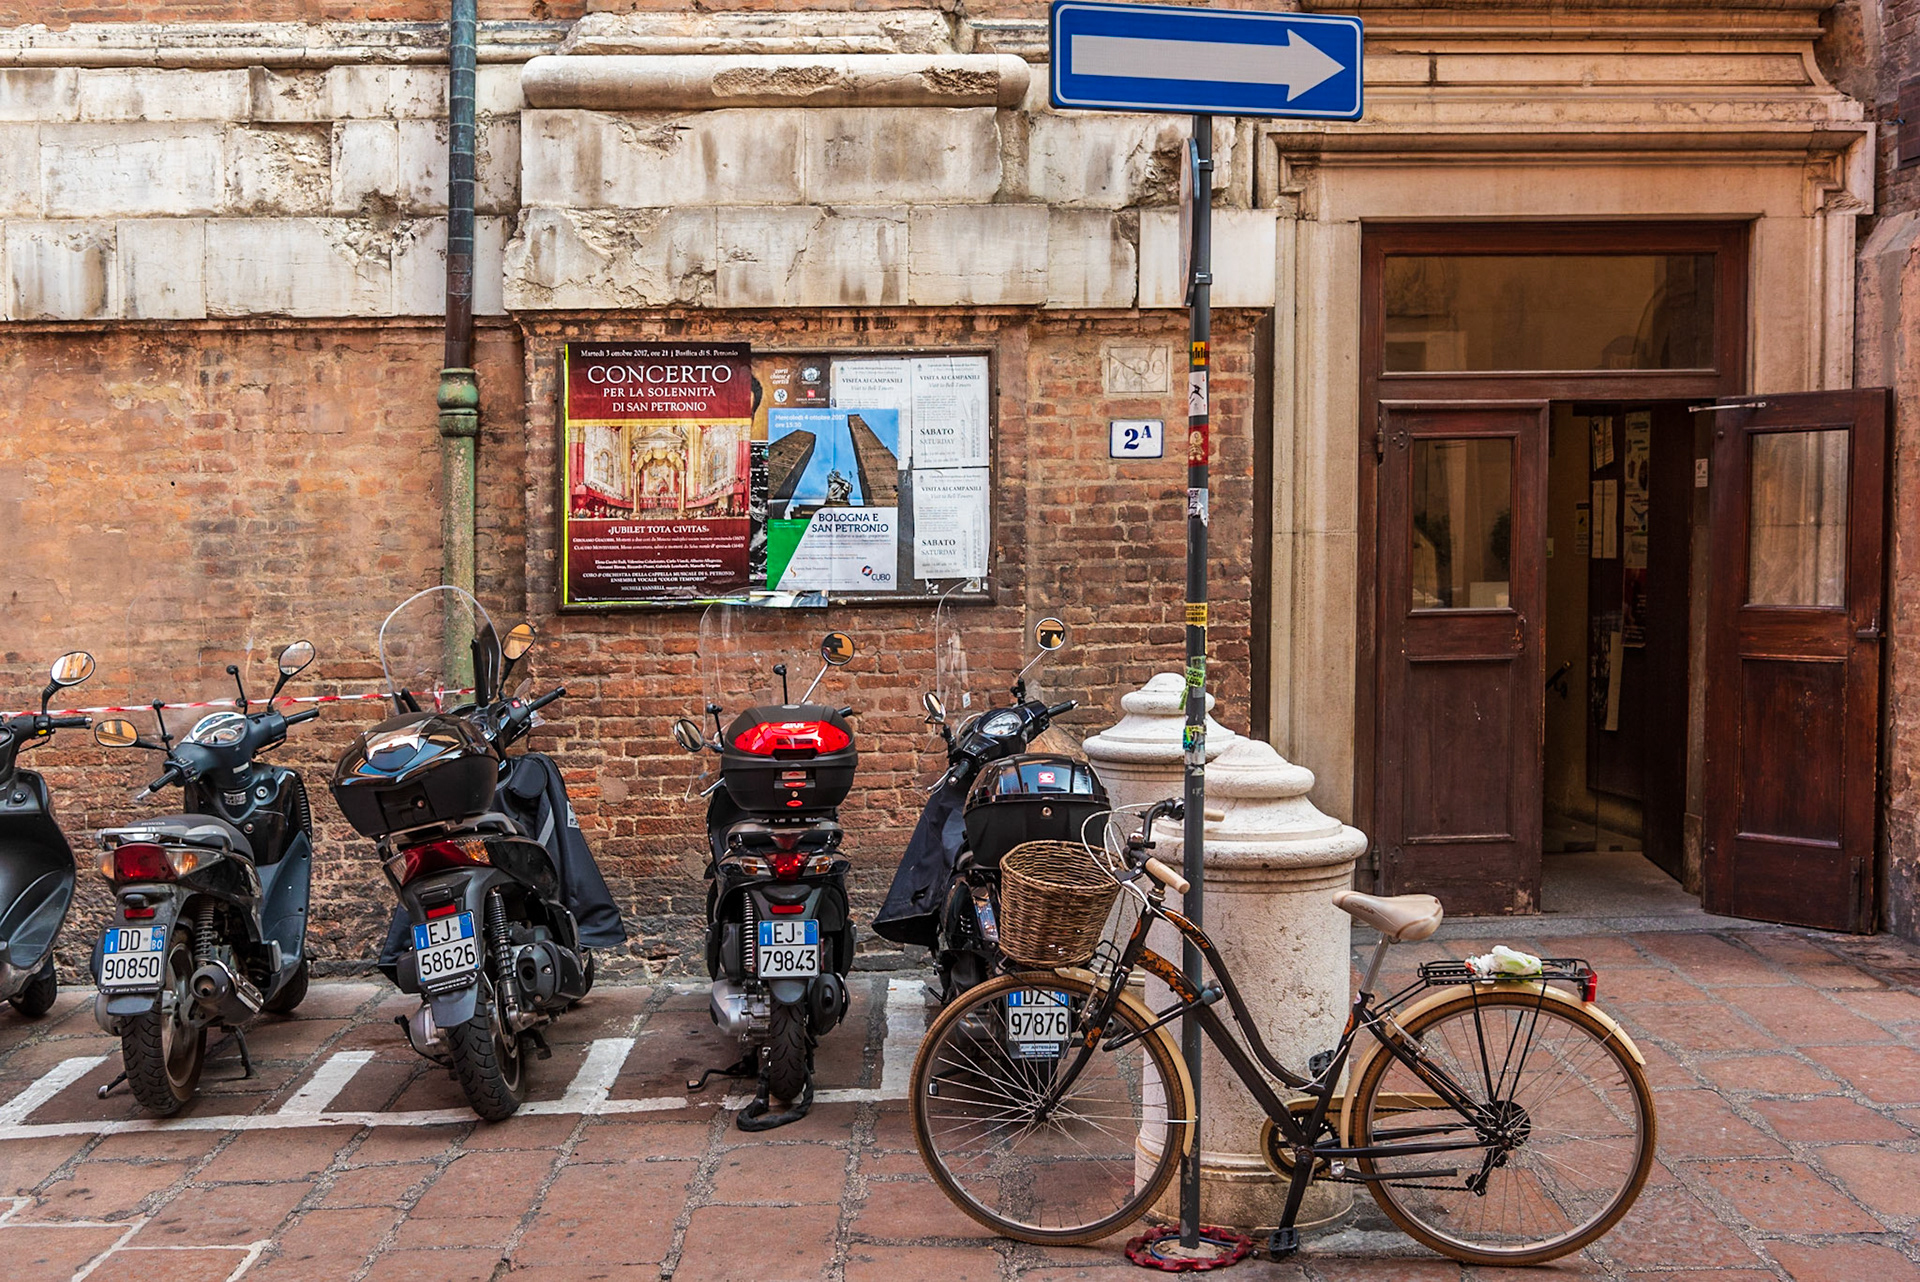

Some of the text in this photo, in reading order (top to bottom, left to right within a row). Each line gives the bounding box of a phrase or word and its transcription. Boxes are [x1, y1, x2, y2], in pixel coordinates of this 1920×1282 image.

[587, 364, 732, 384] CONCERTO
[603, 386, 716, 397] PER LA SOLENNITÀ
[612, 402, 707, 412] DI SAN PETRONIO
[1124, 425, 1152, 450] 2A
[818, 513, 878, 522] BOLOGNA E
[647, 526, 671, 534] TOTA
[812, 524, 889, 532] SAN PETRONIO
[110, 930, 162, 951] I DD BO
[428, 920, 451, 945] EJ
[774, 923, 795, 943] EJ
[105, 957, 160, 980] 90850
[421, 944, 476, 975] 58626
[762, 950, 816, 972] 79843
[1011, 1012, 1066, 1036] 97876
